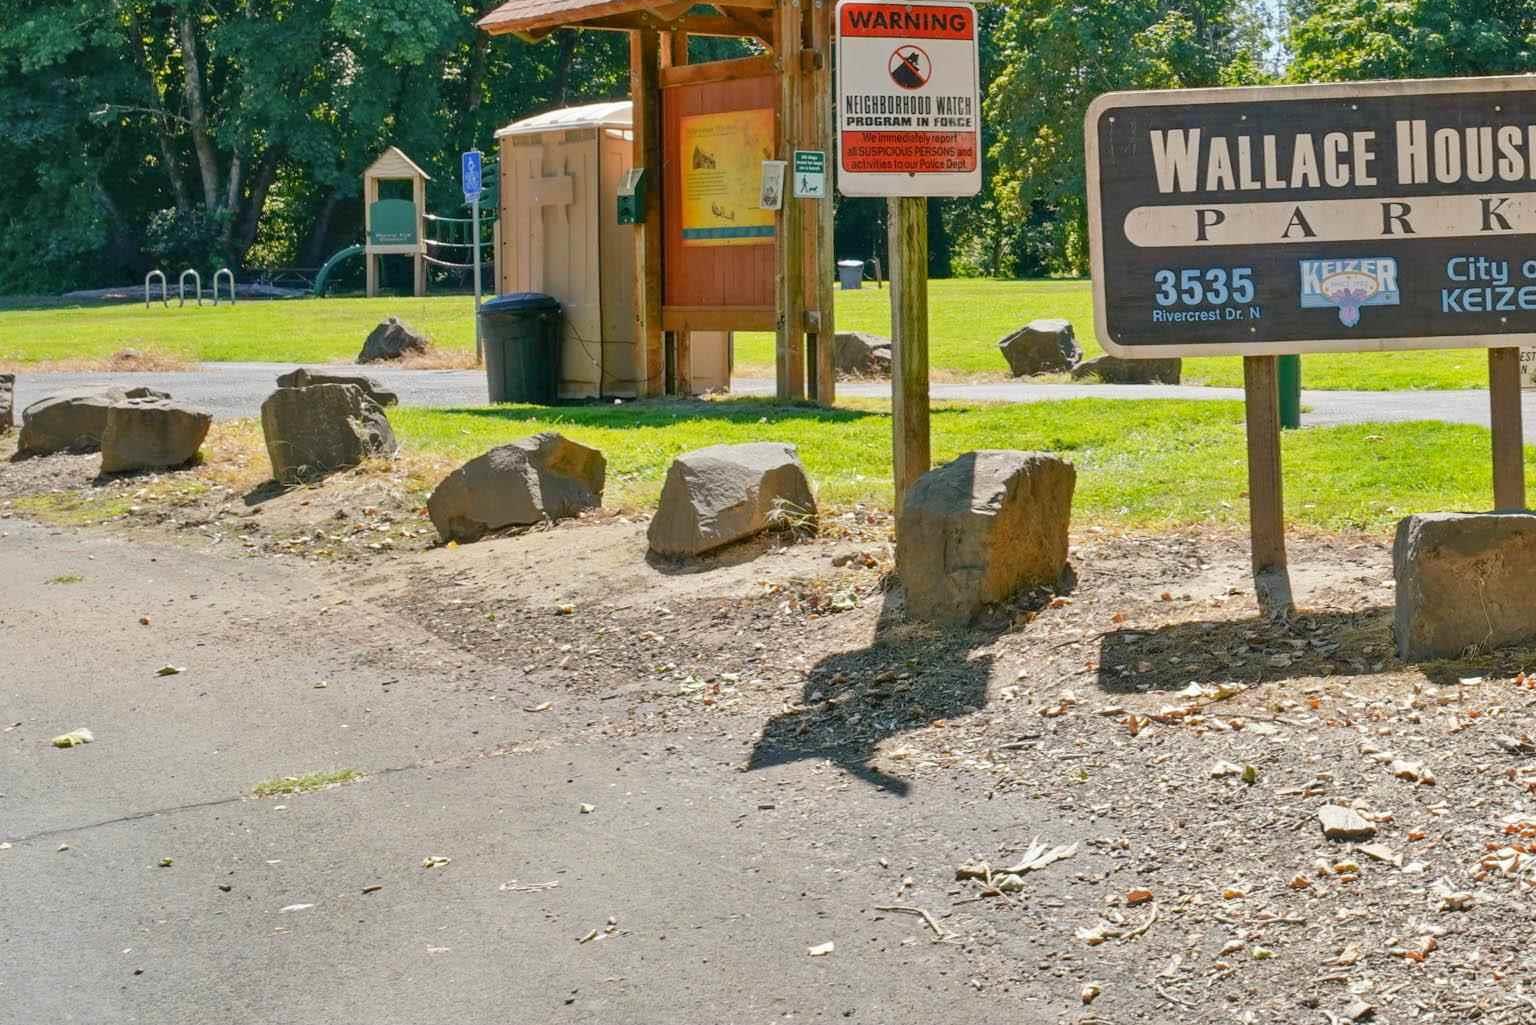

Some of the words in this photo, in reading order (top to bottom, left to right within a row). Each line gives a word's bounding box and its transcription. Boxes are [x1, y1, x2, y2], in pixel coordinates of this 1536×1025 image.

[848, 8, 967, 33] WARNING
[846, 95, 931, 115] NEIGHBORHOOD
[936, 96, 971, 115] WATCH
[847, 117, 911, 127] PROGRAM
[916, 117, 928, 127] IN
[934, 117, 972, 128] FORCE
[863, 133, 877, 143] We
[878, 133, 930, 145] immediately
[932, 134, 957, 145] report
[859, 146, 913, 156] SUSPICIOUS
[915, 146, 955, 156] PERSONS
[957, 148, 973, 156] and
[1150, 127, 1377, 193] WALLACE
[851, 159, 892, 169] activities
[904, 160, 918, 168] our
[920, 158, 944, 168] Police
[1194, 198, 1514, 242] PARK
[1301, 257, 1399, 294] KEIZER
[1447, 256, 1508, 285] City
[1154, 267, 1254, 306] 3535
[1152, 307, 1221, 322] Rivercrest
[1225, 307, 1244, 320] Dr.
[1249, 306, 1260, 319] N
